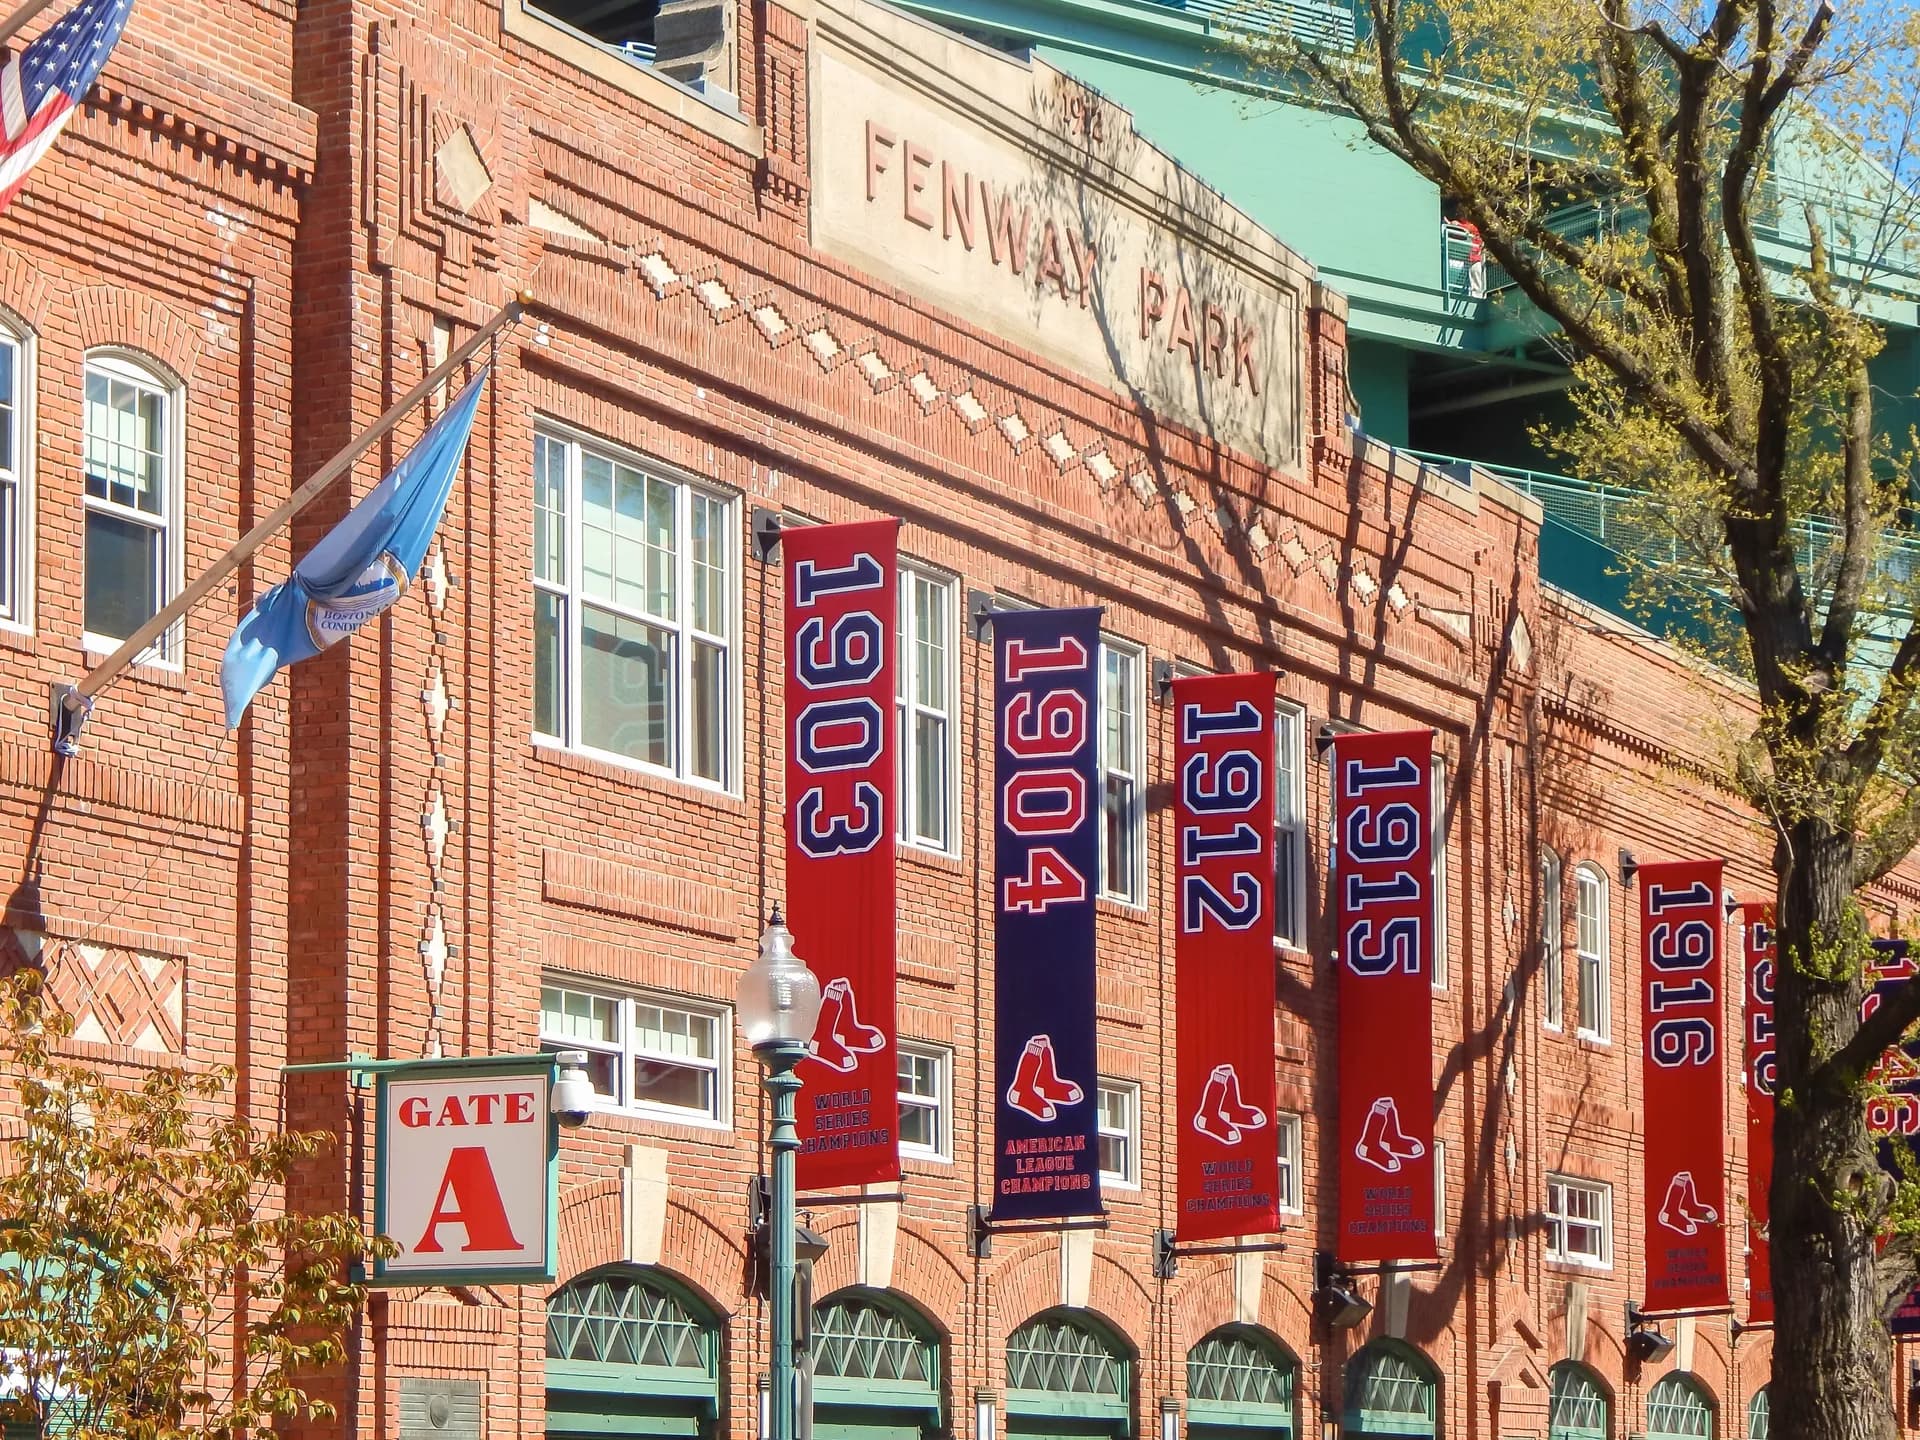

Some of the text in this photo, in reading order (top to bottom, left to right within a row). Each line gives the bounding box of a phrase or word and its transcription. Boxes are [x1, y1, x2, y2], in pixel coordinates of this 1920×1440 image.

[866, 119, 1260, 397] FENWAY PARK
[796, 552, 884, 858] 1903
[1003, 636, 1087, 913] 1904
[1183, 700, 1262, 934] 1912
[1346, 756, 1420, 976] 1915
[1649, 881, 1714, 1067] 1916
[1862, 957, 1920, 1136] 146
[398, 1092, 536, 1128] GATE
[814, 1088, 871, 1110] WORLD
[815, 1110, 870, 1131] SERIES
[1004, 1135, 1086, 1155] AMERICAN
[1016, 1155, 1075, 1174] LEAGUE
[1201, 1159, 1253, 1176] WORLD
[413, 1146, 525, 1253] A
[1001, 1174, 1091, 1195] CHAMPIONS
[1186, 1193, 1270, 1213] CHAMPIONS
